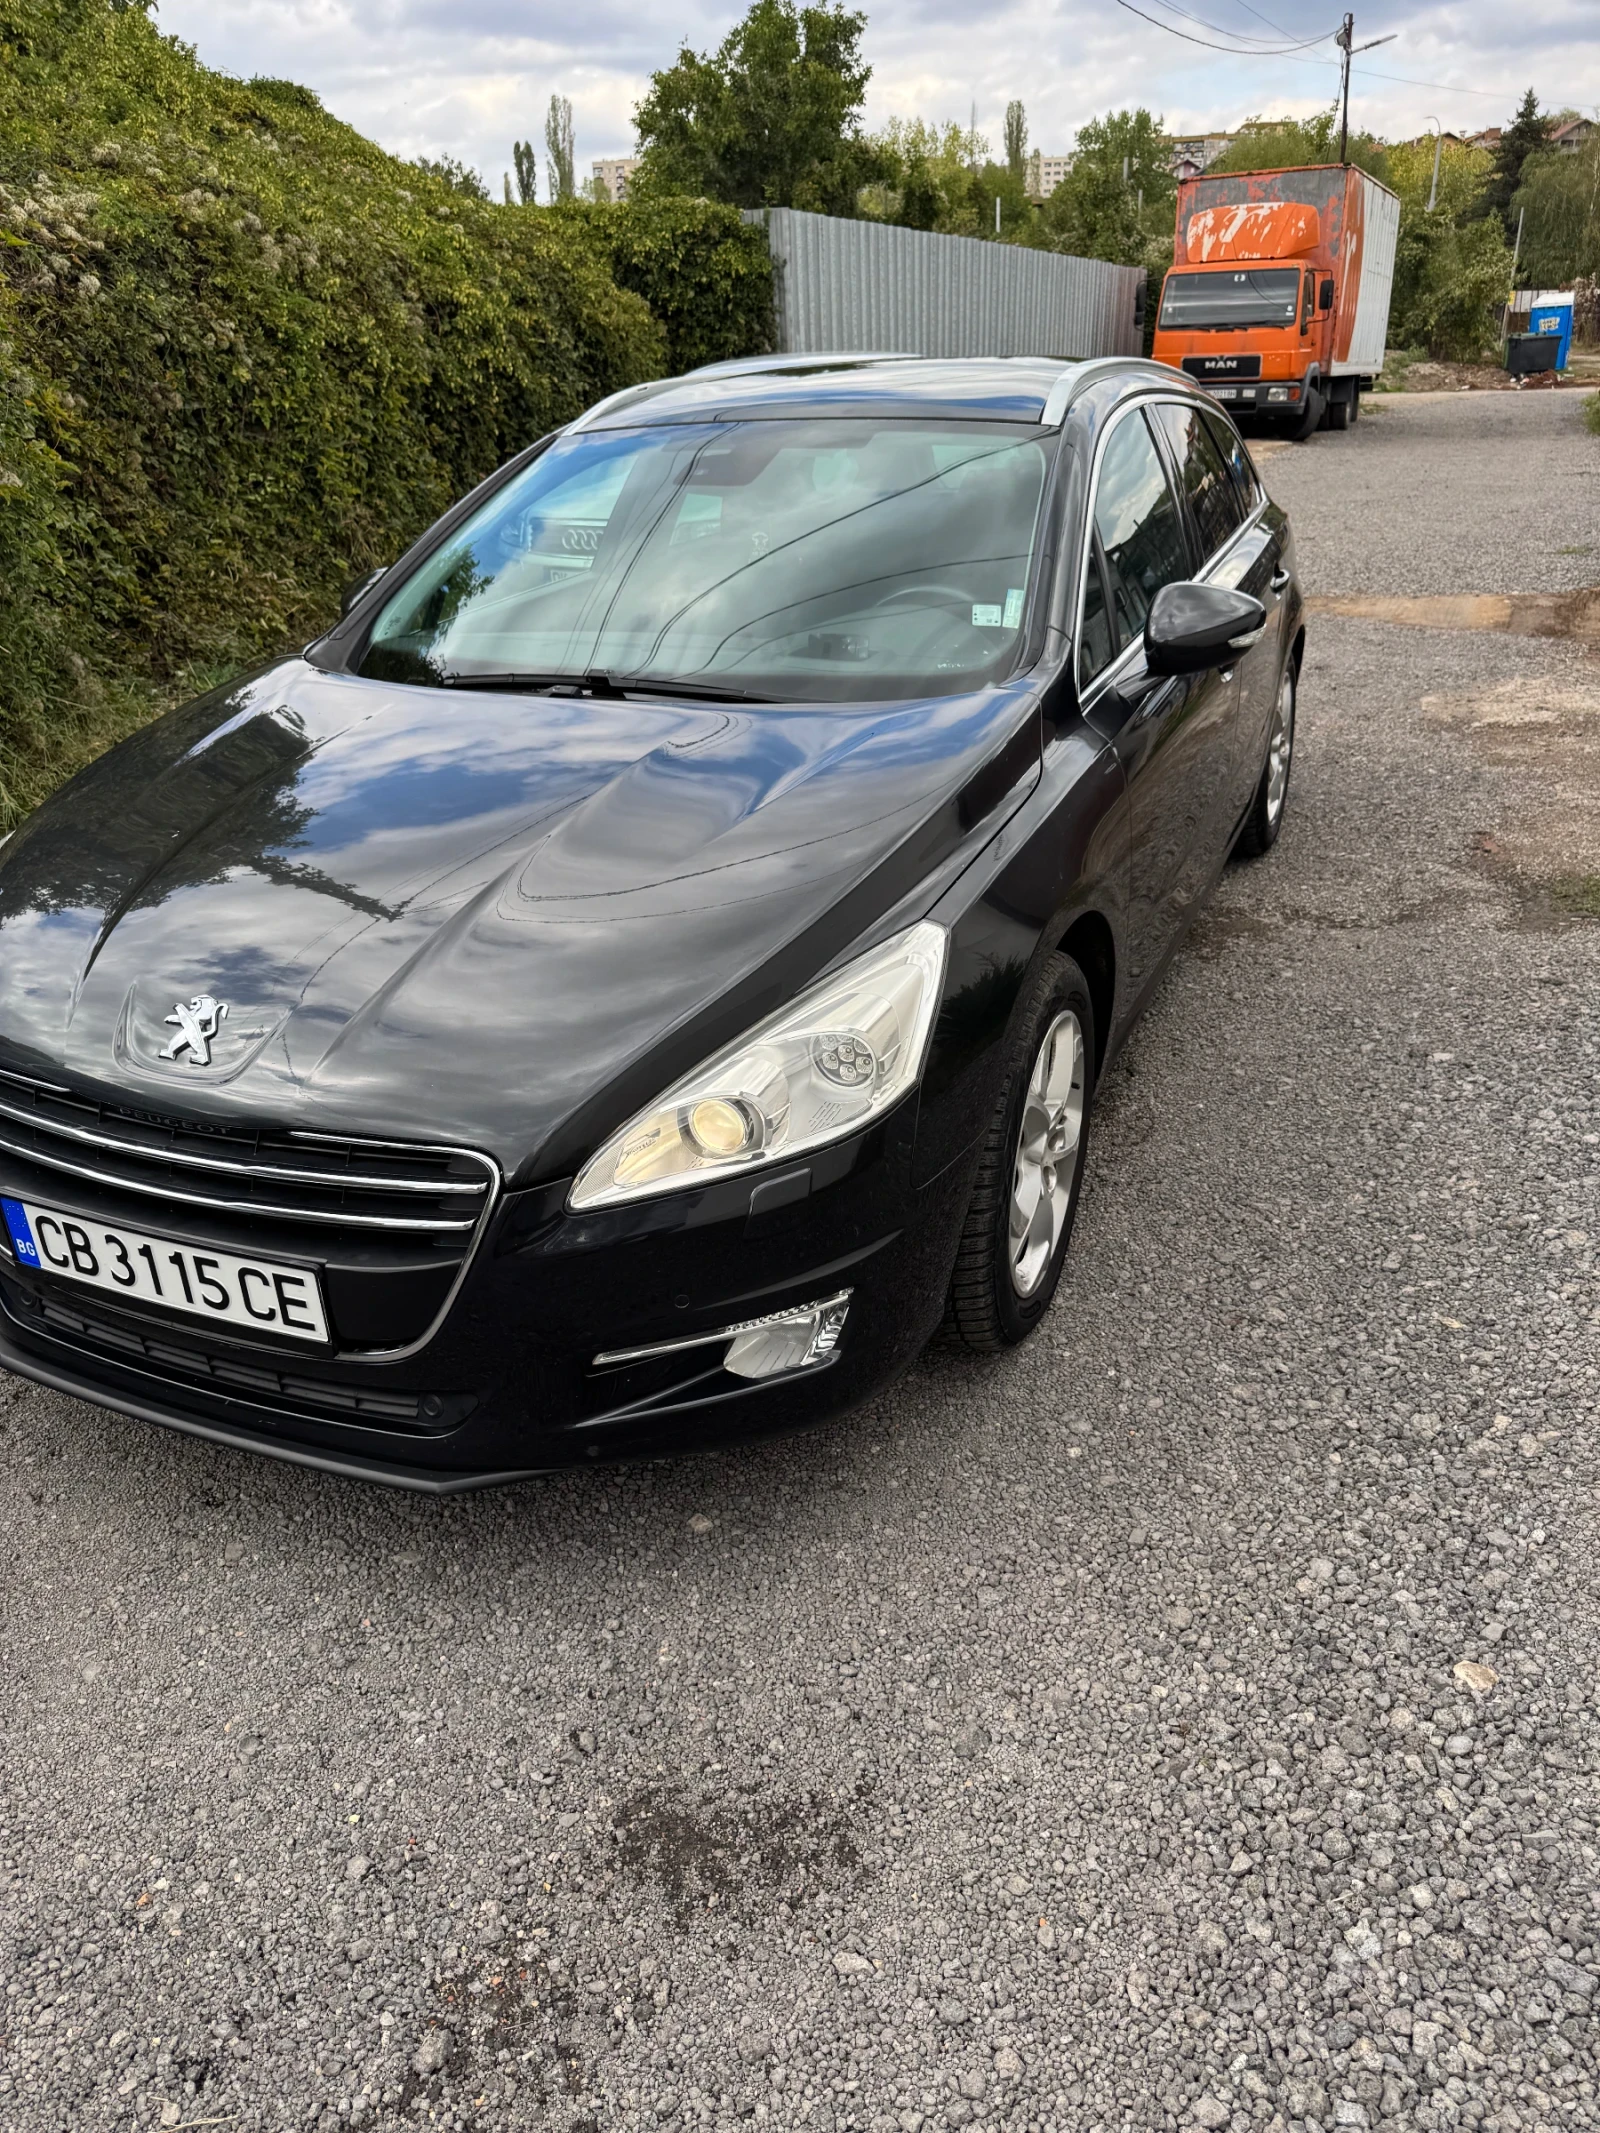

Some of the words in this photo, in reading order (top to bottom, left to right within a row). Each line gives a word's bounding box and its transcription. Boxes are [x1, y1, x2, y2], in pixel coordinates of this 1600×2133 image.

[1204, 360, 1238, 369] MAN
[119, 1106, 231, 1134] PEUGEOT
[15, 1237, 36, 1257] BG
[34, 1214, 100, 1277] CB
[104, 1233, 230, 1311] 3115
[237, 1266, 316, 1332] CE
